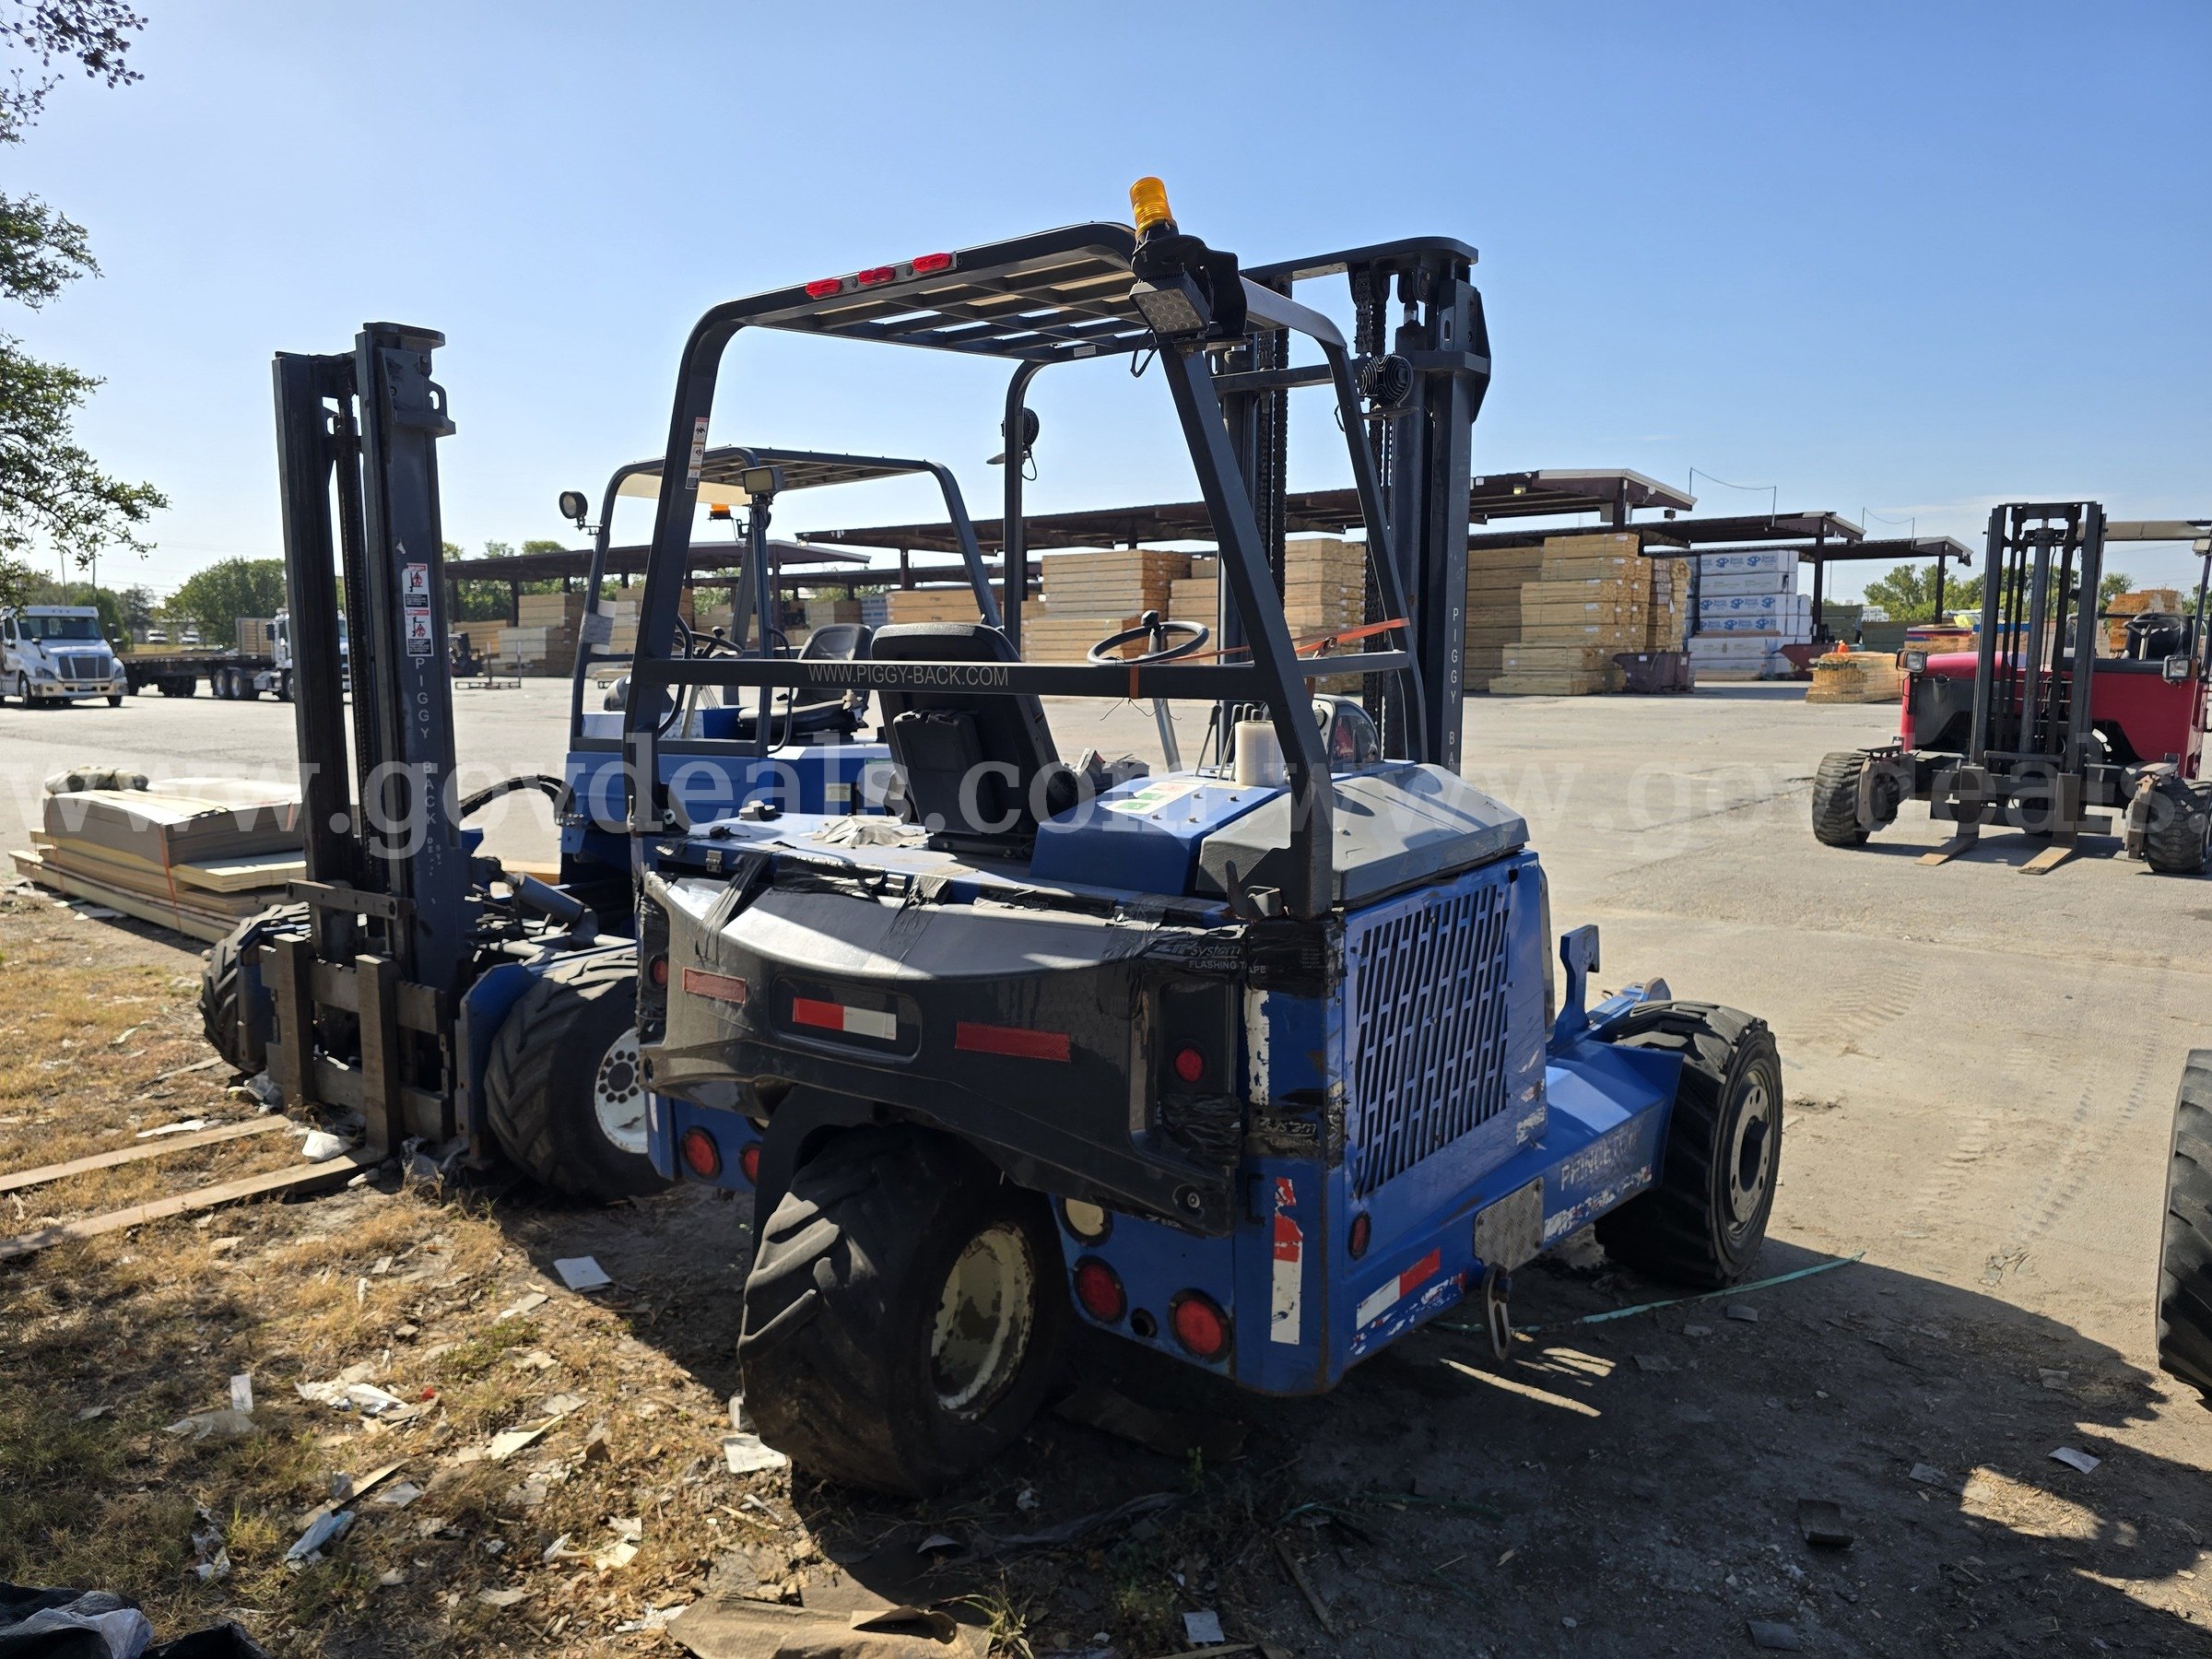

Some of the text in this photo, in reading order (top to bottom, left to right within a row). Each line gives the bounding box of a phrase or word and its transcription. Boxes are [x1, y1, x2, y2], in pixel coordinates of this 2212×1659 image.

[808, 664, 1009, 687] WWW.PIGGY-BACK.COM
[1450, 607, 1459, 704] PIGGY
[415, 657, 430, 739] PIGGY
[422, 761, 438, 825] BACK
[1189, 960, 1237, 970] FLASHING
